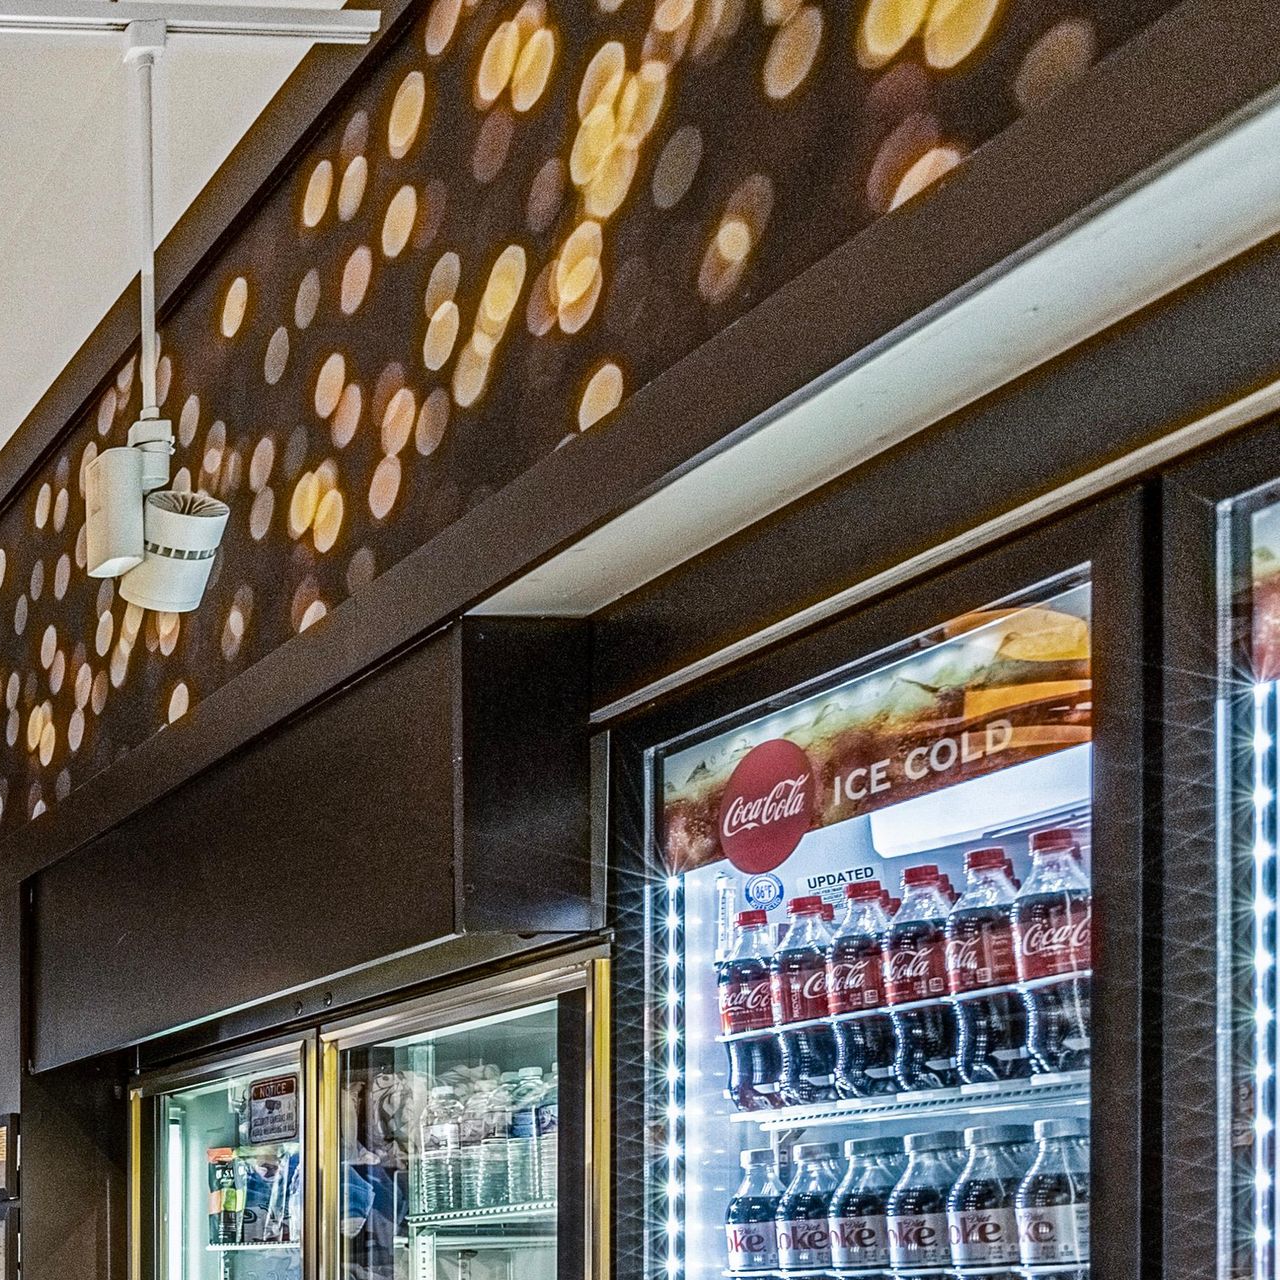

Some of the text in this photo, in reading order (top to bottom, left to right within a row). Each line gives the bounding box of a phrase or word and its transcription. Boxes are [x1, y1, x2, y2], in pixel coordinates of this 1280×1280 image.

[833, 718, 1014, 807] ICE COLD
[722, 771, 811, 838] Coca-Cola
[807, 866, 874, 889] UPDATED
[260, 1083, 287, 1098] NOTICE
